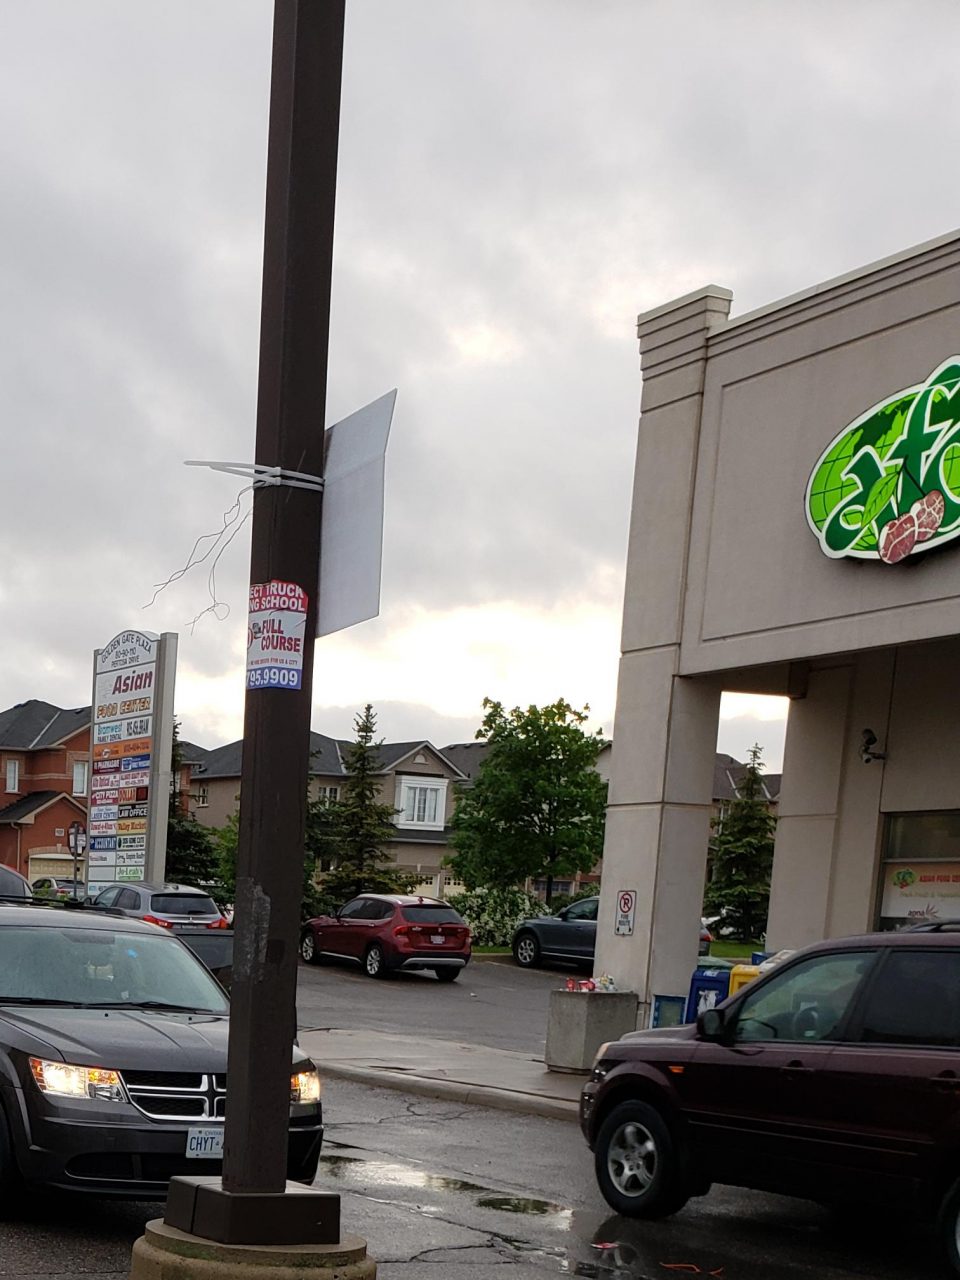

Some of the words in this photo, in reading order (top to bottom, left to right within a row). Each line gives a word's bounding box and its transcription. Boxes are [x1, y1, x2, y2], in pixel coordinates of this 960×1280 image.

[266, 582, 304, 598] TRUCK
[261, 595, 305, 611] SCHOOL
[262, 618, 284, 635] FULL
[102, 638, 120, 663] GOLDEN
[122, 633, 135, 644] GATE
[136, 635, 152, 655] PLAZA
[261, 634, 301, 653] COURSE
[112, 670, 153, 695] Asian
[97, 702, 118, 719] FOOD
[120, 697, 151, 714] CENTER
[130, 808, 148, 817] OFFICE
